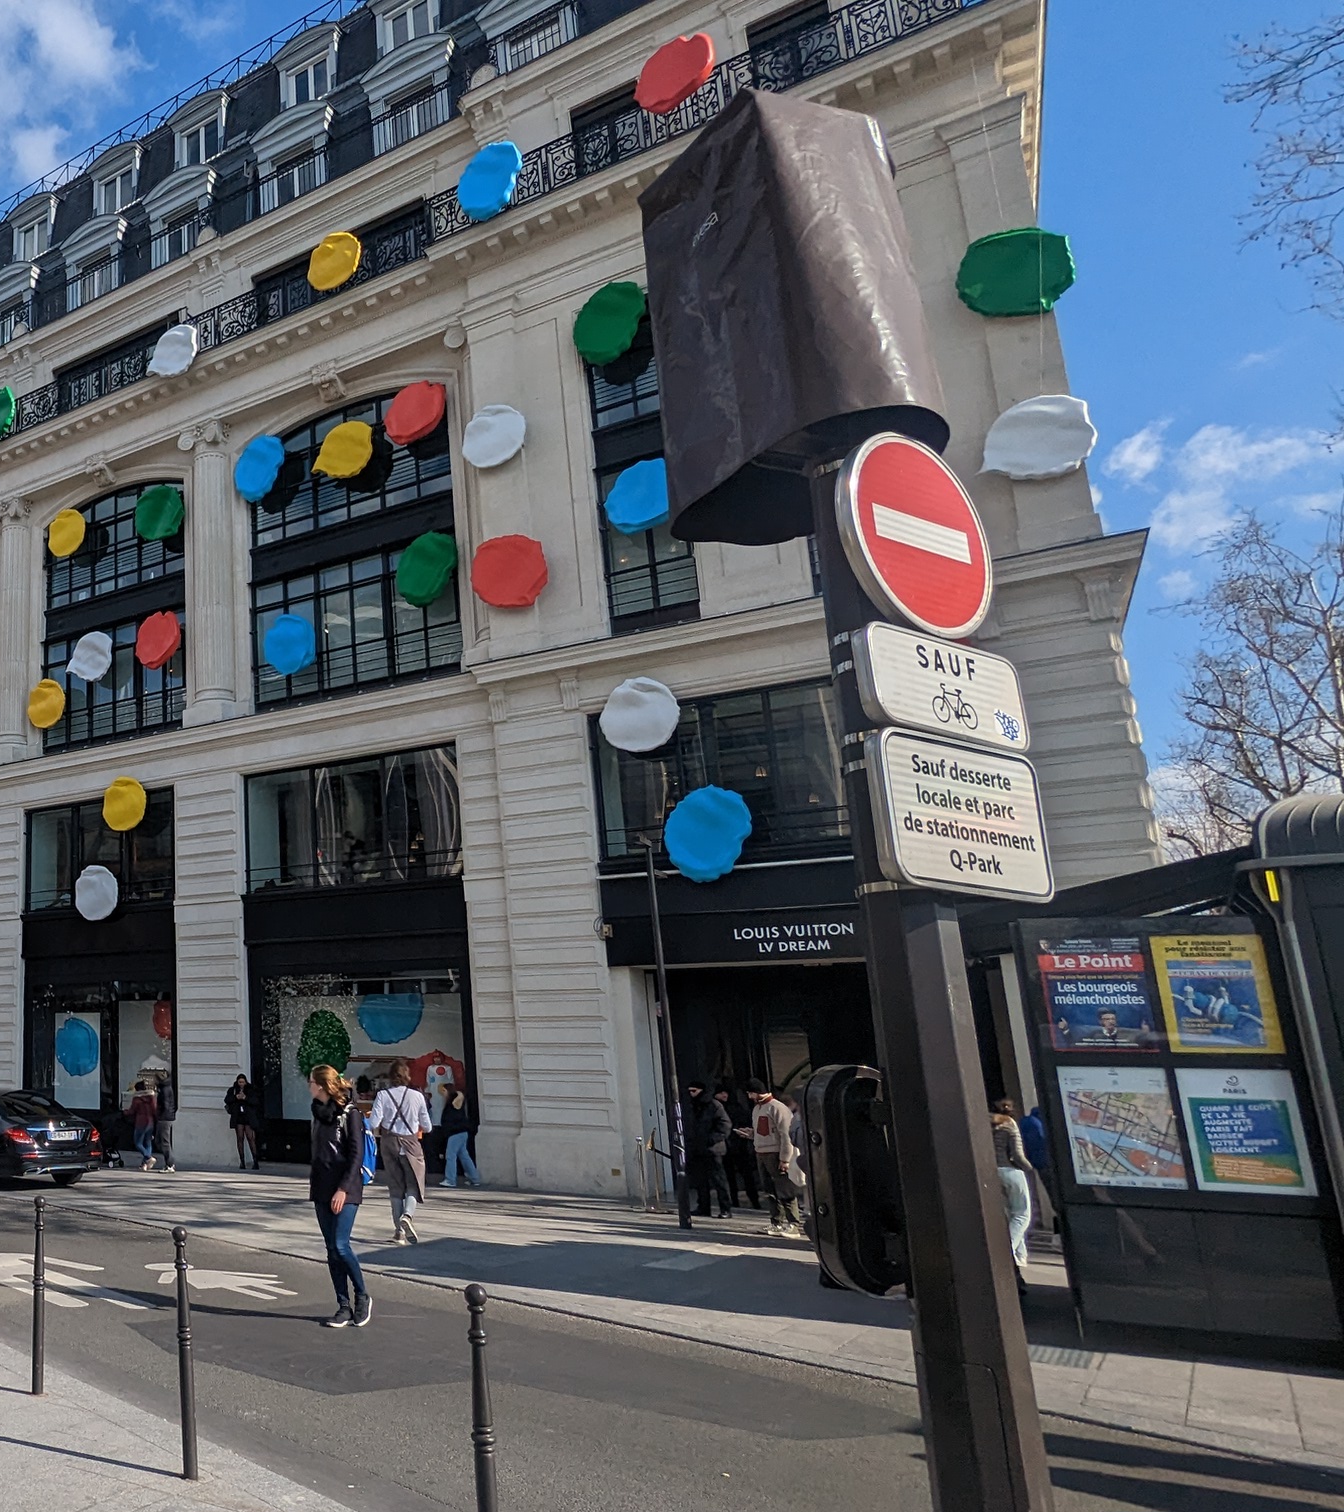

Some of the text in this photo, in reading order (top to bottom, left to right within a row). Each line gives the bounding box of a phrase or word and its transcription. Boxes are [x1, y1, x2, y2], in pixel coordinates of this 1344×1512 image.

[915, 644, 976, 681] SAUF
[911, 753, 1012, 792] Sauf desserte
[915, 783, 1016, 821] locale et parc
[903, 811, 1037, 852] de stationnement
[949, 849, 1004, 876] Q-Park
[733, 922, 855, 940] LOUIS VUITTON
[758, 939, 831, 953] LV DREAM
[1052, 953, 1133, 968] Le Point
[1056, 981, 1138, 994] Les bourgeois
[1054, 993, 1146, 1005] mélenchonistes
[1199, 1105, 1231, 1113] QUAND
